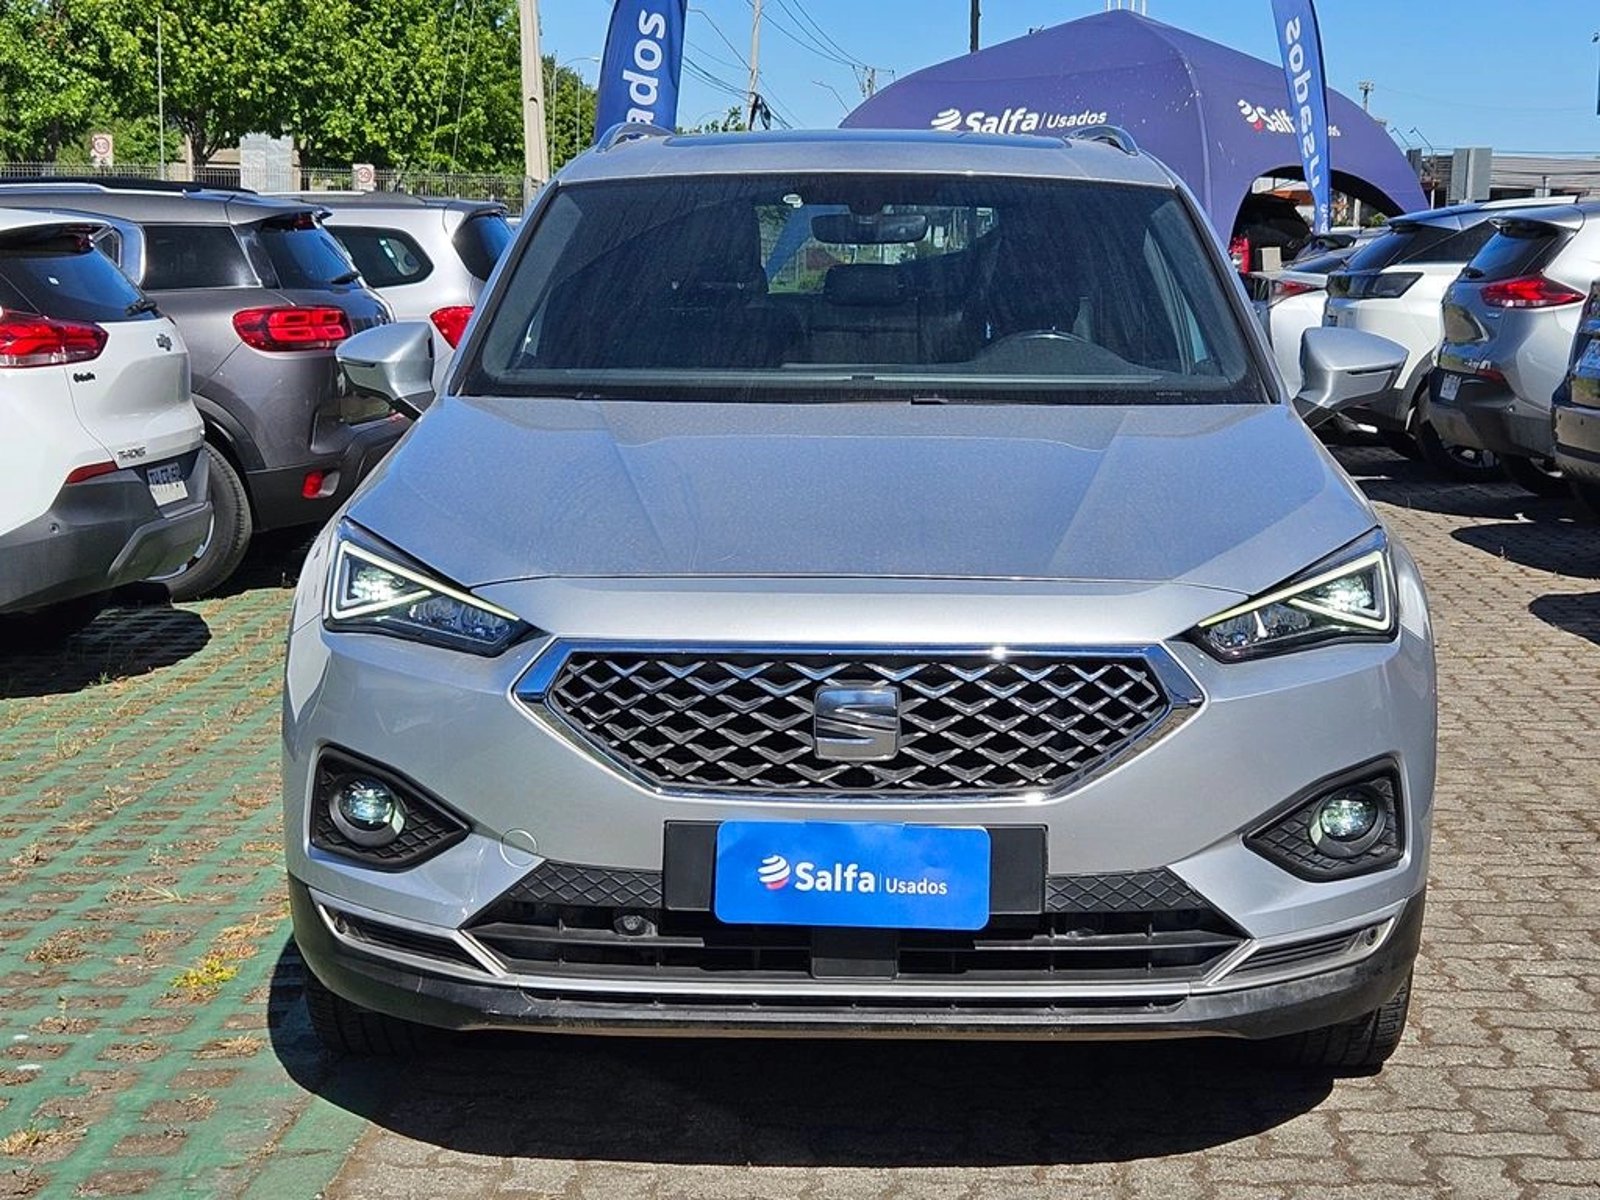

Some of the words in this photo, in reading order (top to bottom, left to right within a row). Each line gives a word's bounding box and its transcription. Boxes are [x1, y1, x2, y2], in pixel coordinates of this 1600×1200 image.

[622, 9, 666, 125] ados
[966, 107, 1040, 135] Salfa
[1047, 110, 1107, 129] Usados
[1256, 106, 1296, 133] Salf
[795, 862, 875, 893] Salfa
[885, 878, 948, 895] Usados
